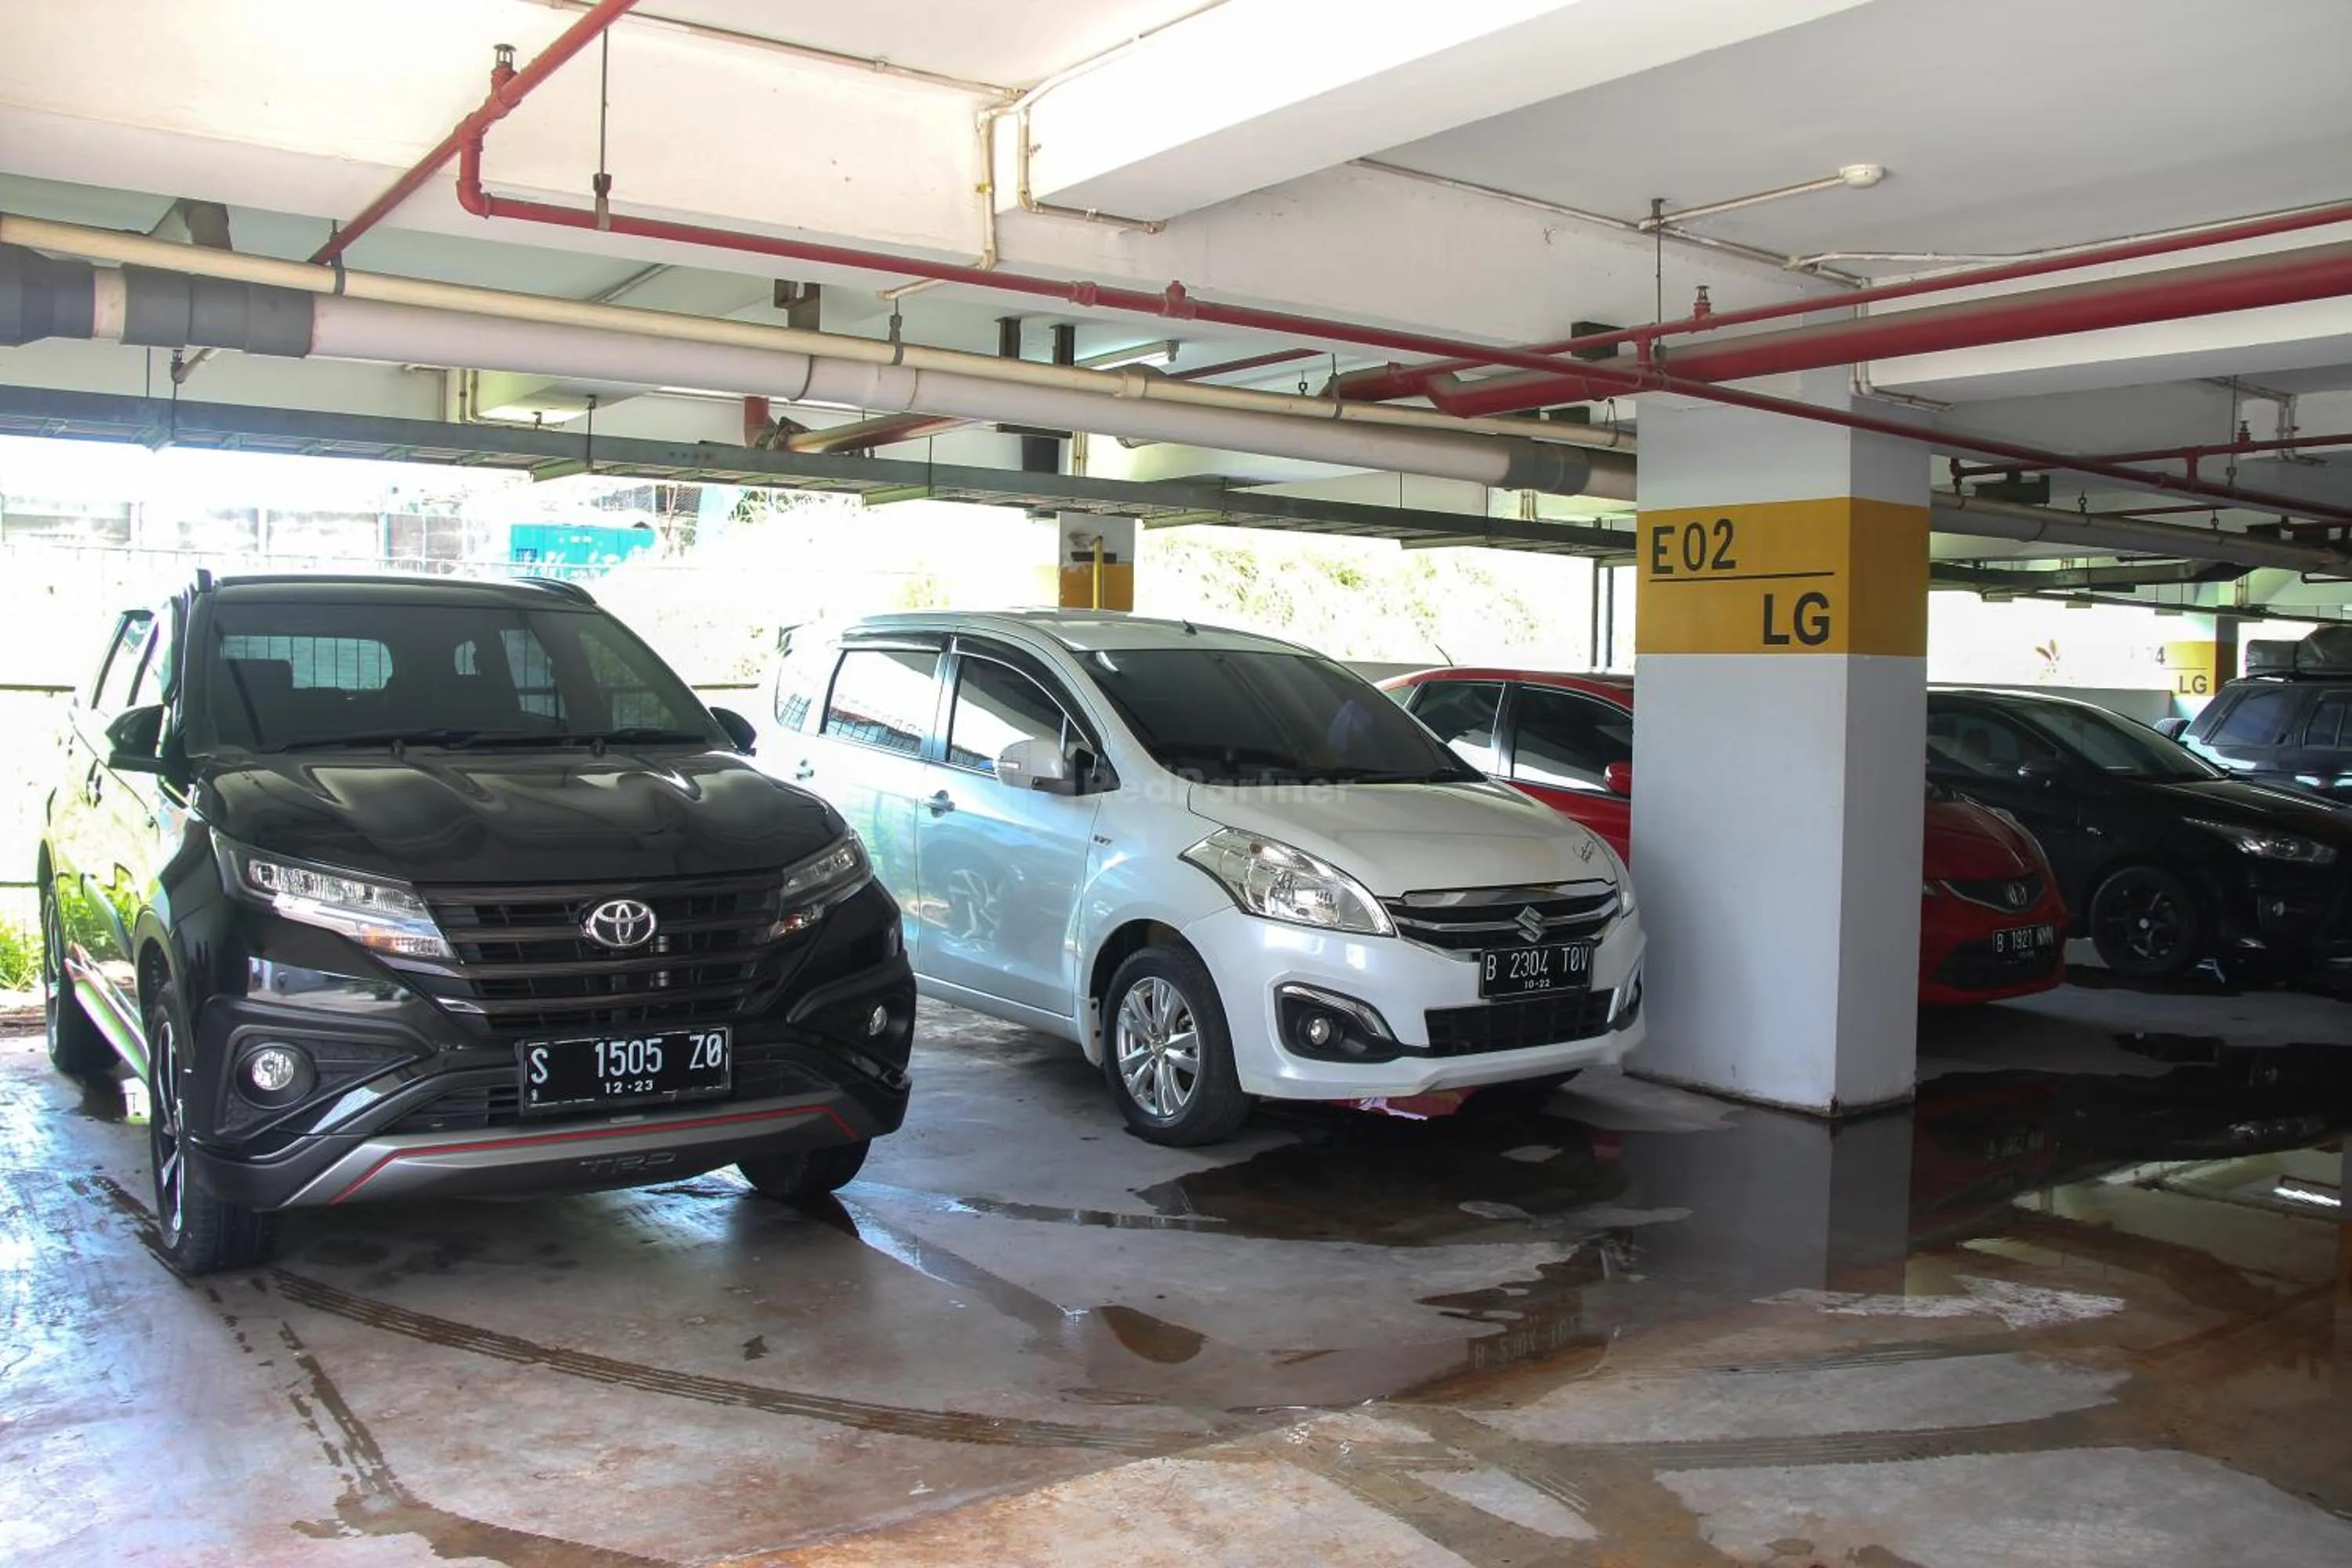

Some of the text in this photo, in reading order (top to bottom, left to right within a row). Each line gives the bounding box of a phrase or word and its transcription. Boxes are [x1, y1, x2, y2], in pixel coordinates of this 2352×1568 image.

[1651, 518, 1736, 575] E02
[1762, 592, 1830, 646] LG
[2179, 675, 2208, 694] LG
[1996, 933, 2004, 953] B
[1486, 954, 1497, 980] B
[1510, 950, 1548, 978] 2304
[531, 1048, 548, 1084] S
[595, 1038, 662, 1077] 1505
